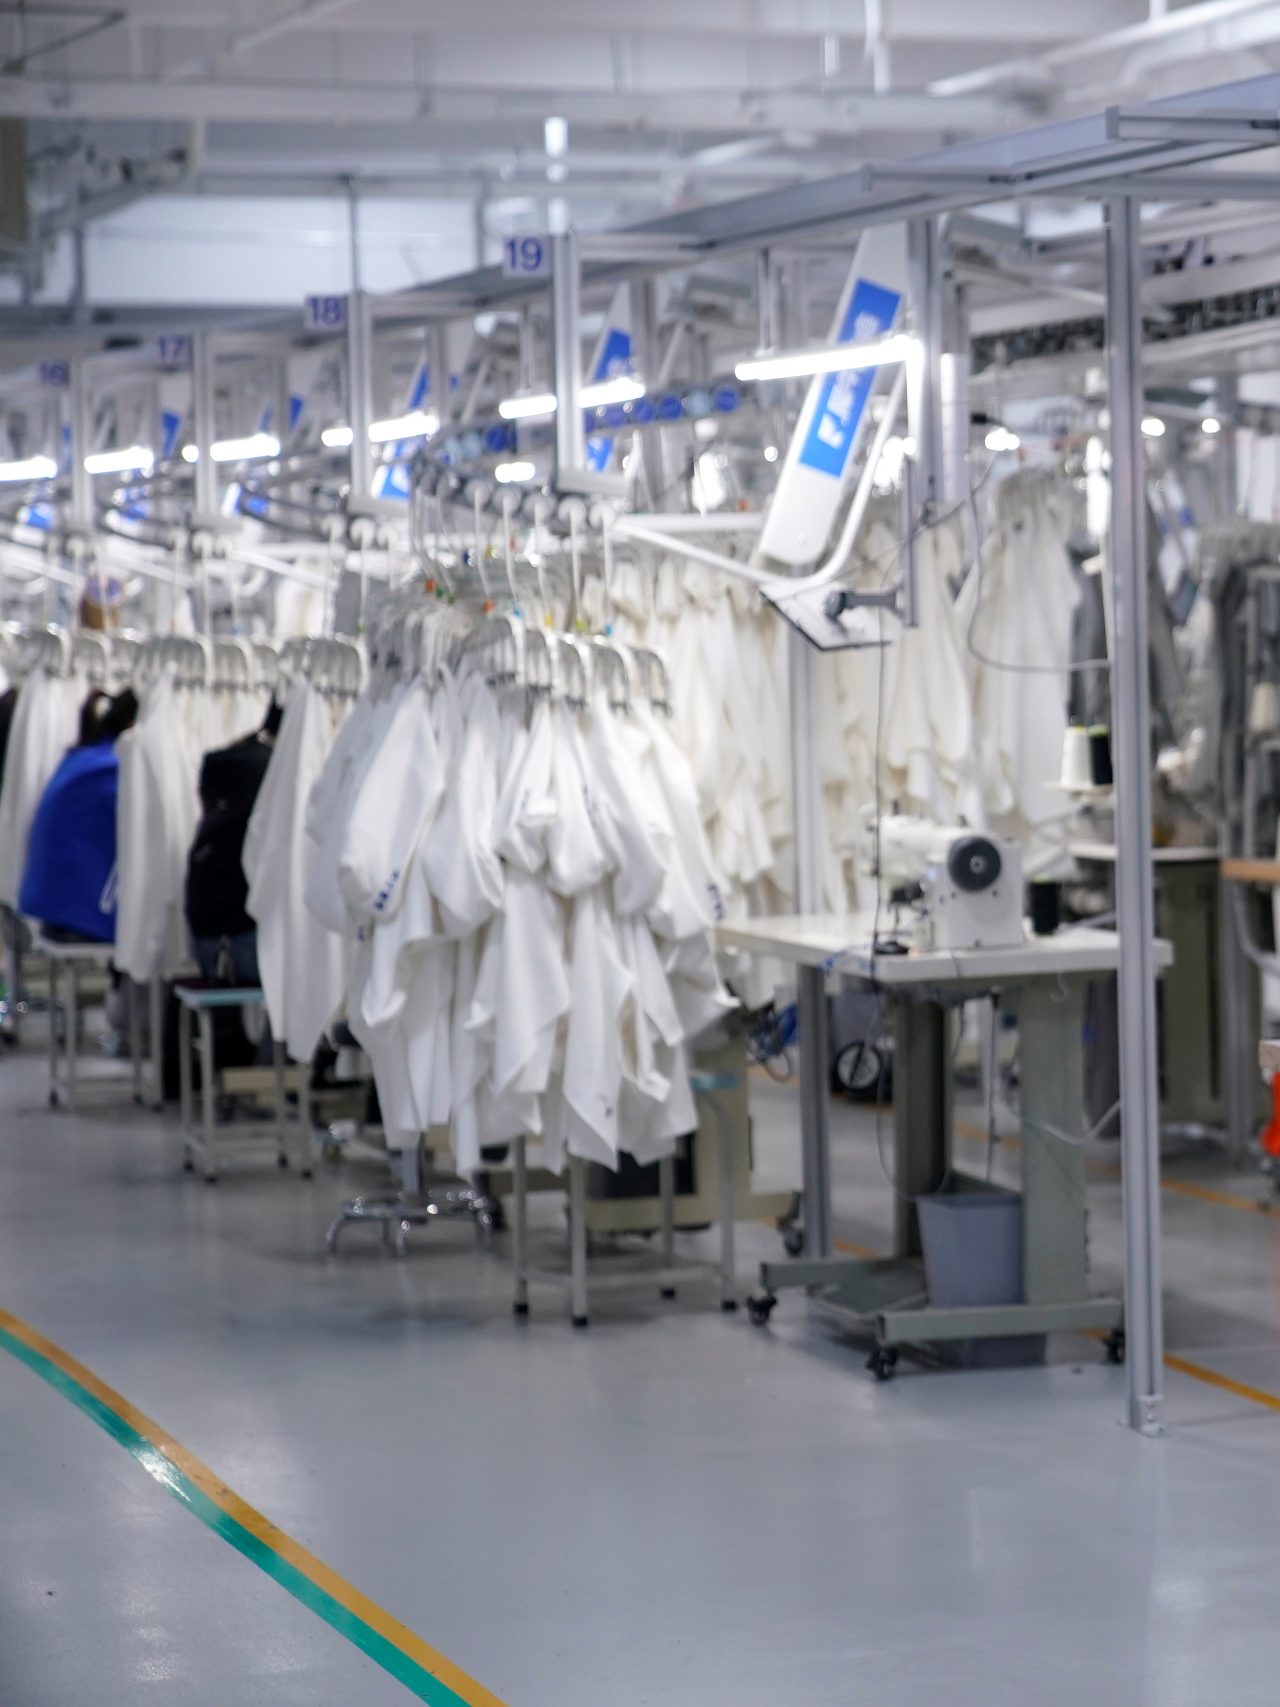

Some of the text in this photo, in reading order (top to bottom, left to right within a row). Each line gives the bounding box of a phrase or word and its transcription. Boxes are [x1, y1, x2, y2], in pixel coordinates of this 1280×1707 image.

[505, 237, 543, 272] 19
[308, 297, 343, 325] 18
[157, 336, 187, 360] 17
